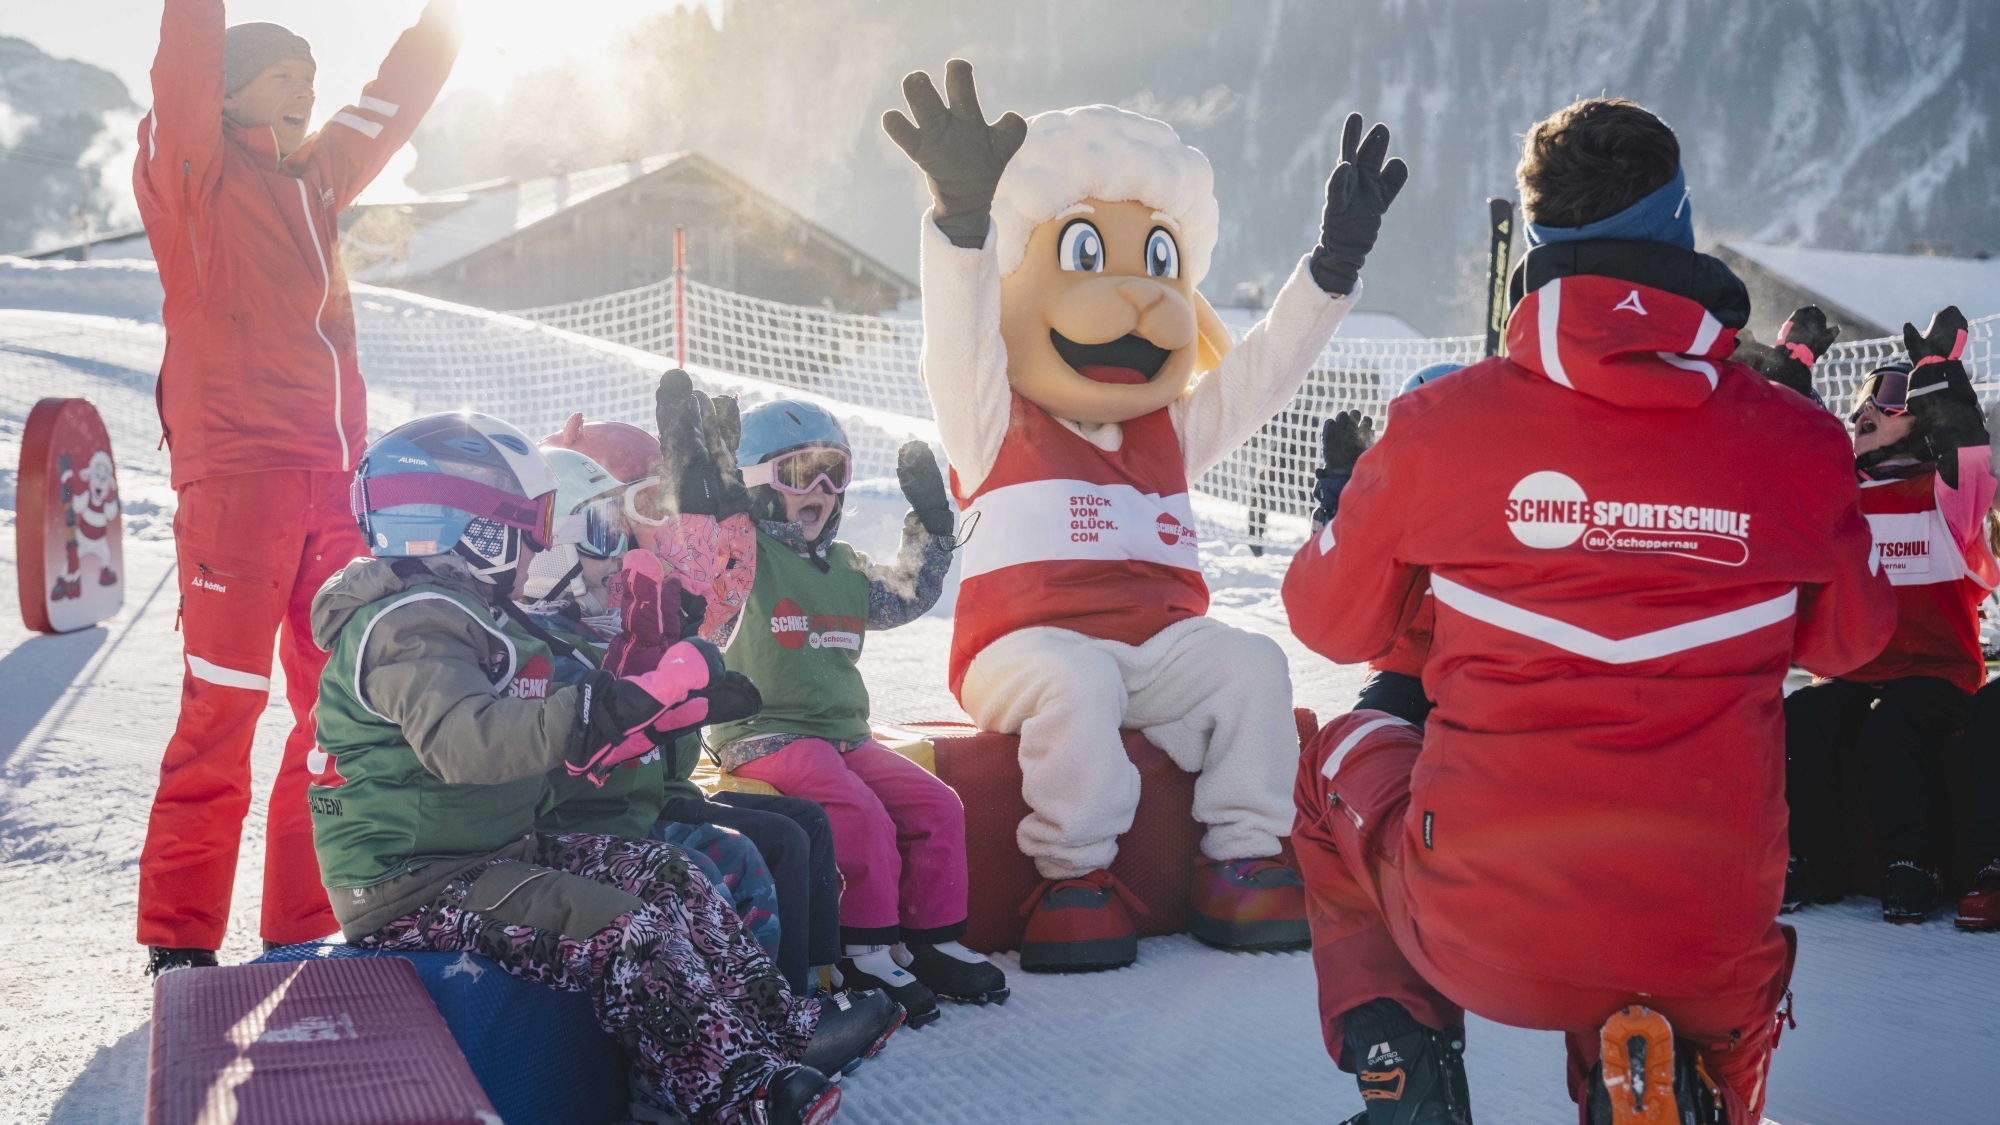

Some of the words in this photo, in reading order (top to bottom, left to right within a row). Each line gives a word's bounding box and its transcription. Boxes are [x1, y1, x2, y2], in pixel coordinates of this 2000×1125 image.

[1492, 240, 1508, 333] FISCHER
[398, 457, 428, 466] ALPINA
[1069, 495, 1112, 507] STÜCK
[1070, 508, 1099, 517] VOM
[1070, 518, 1119, 531] GLÜCK.
[1070, 532, 1099, 542] COM
[1589, 537, 1604, 546] au
[1616, 537, 1698, 550] schoppernau
[1875, 541, 1930, 557] TSCHUL
[583, 683, 592, 725] reusch
[1368, 1051, 1398, 1066] QUATTRO
